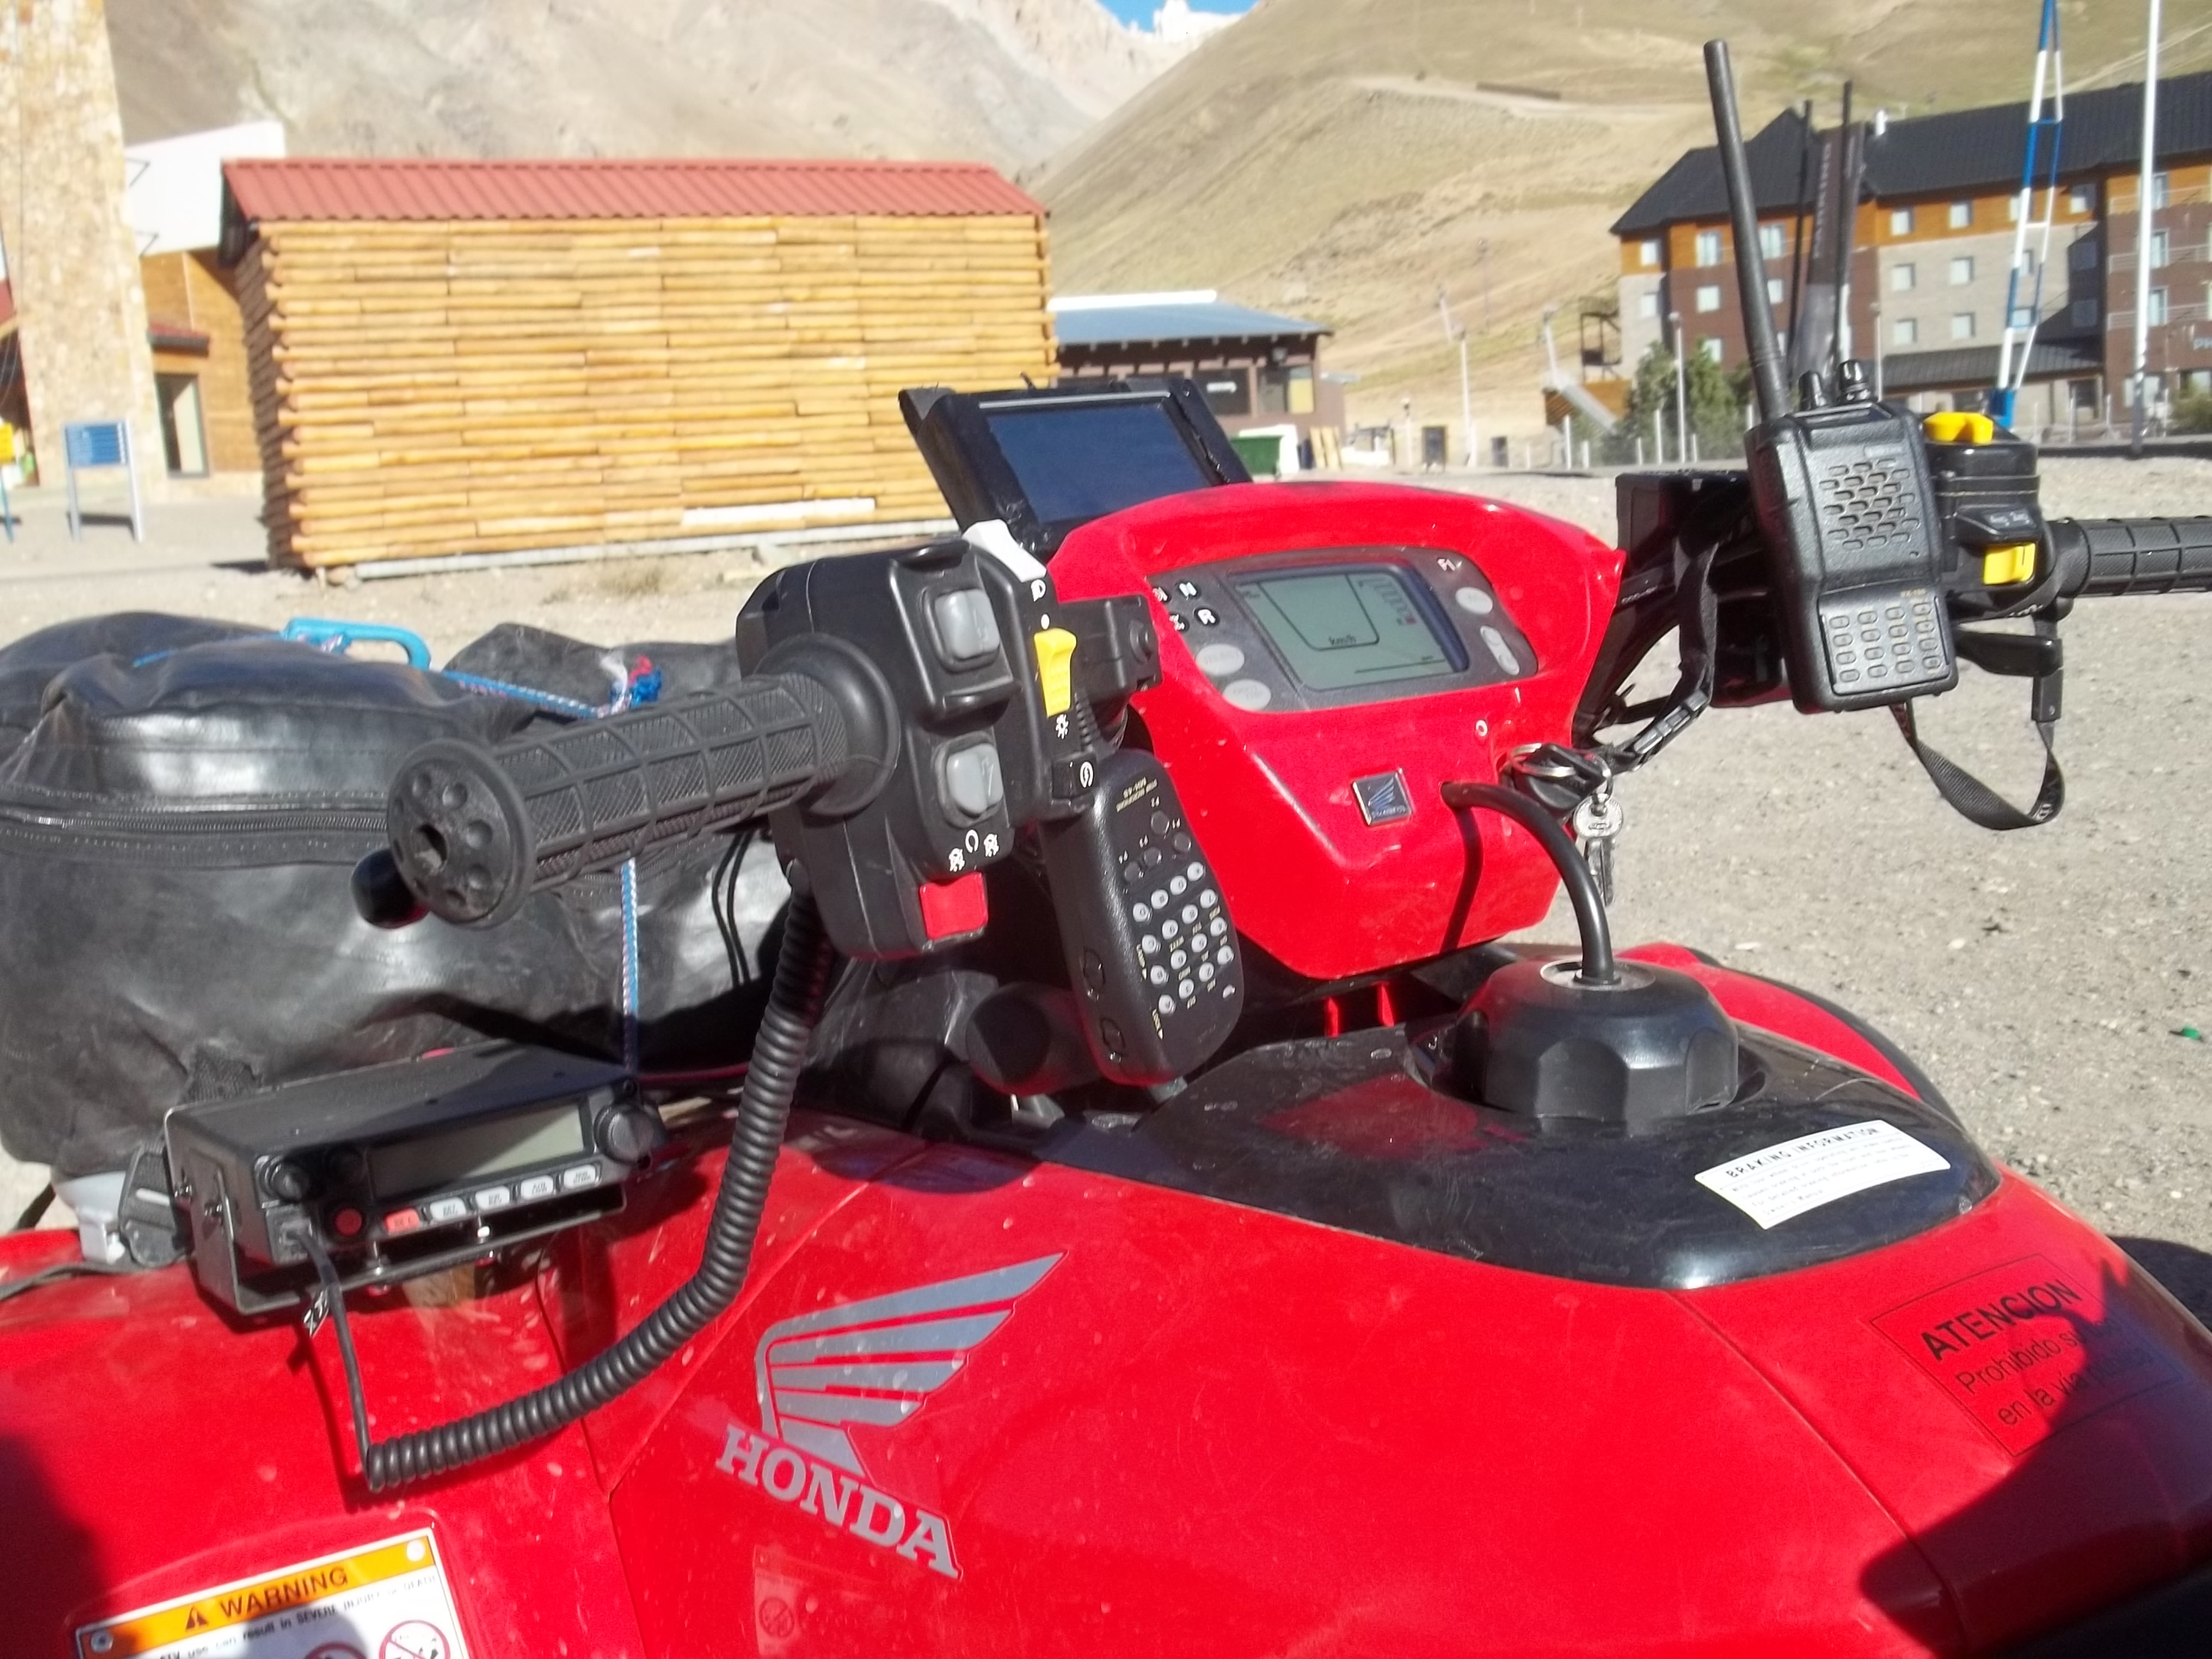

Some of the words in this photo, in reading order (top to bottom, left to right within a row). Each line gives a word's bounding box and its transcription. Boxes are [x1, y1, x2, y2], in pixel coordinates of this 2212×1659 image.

[1178, 581, 1197, 597] N
[1197, 608, 1217, 625] R
[1725, 1151, 1792, 1179] BRAKING
[1792, 1127, 1882, 1159] INFORMATION
[1921, 1279, 2084, 1361] ATENCION
[1955, 1334, 2062, 1396] Prohibido
[1998, 1400, 2033, 1426] en
[2025, 1385, 2056, 1408] la
[715, 1424, 959, 1580] HONDA
[220, 1566, 349, 1619] WARNING
[243, 1621, 276, 1641] result
[280, 1616, 293, 1630] in
[296, 1604, 337, 1625] SEVERE
